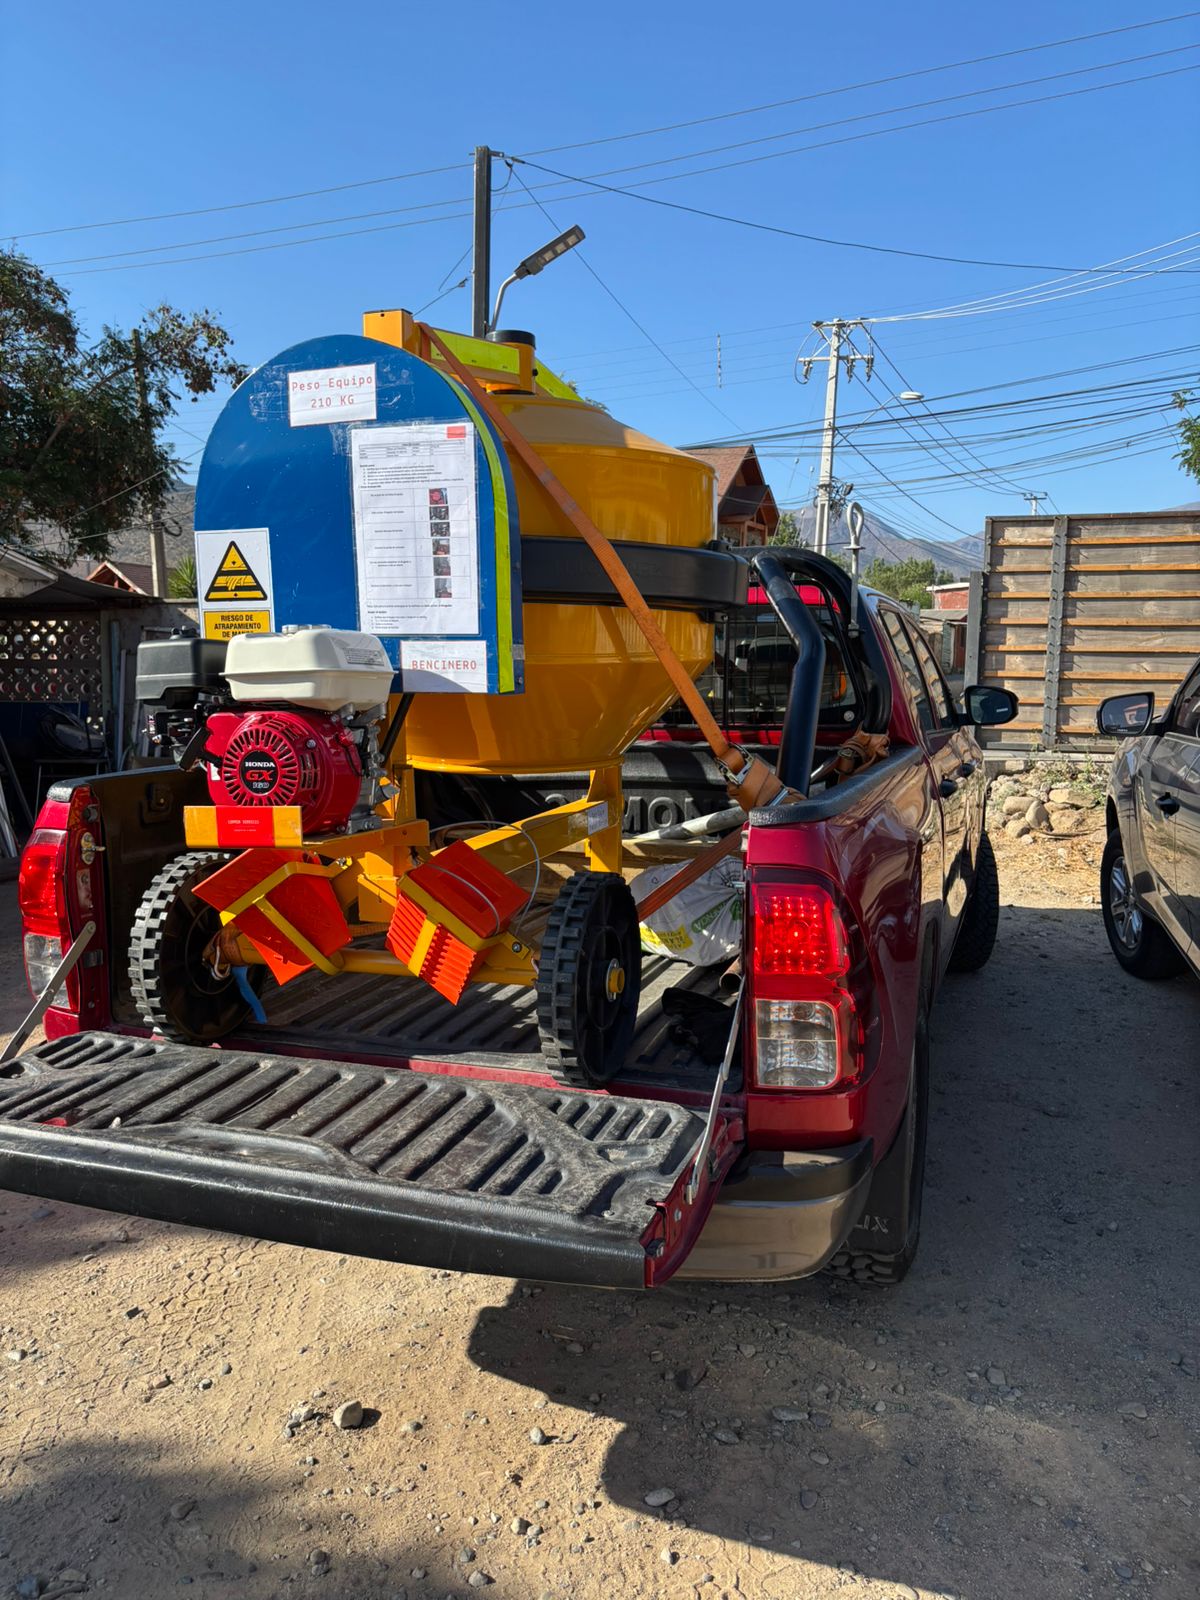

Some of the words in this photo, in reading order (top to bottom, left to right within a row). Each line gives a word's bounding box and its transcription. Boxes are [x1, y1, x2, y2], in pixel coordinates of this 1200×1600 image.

[292, 381, 320, 391] Peso
[328, 375, 373, 389] Equipo
[311, 397, 332, 408] 210
[340, 394, 354, 406] KG
[220, 614, 244, 622] RIESGO
[245, 614, 254, 622] DE
[214, 622, 262, 630] ATRAPAMIENTO
[411, 660, 477, 670] BENCINERO
[245, 770, 274, 782] GX
